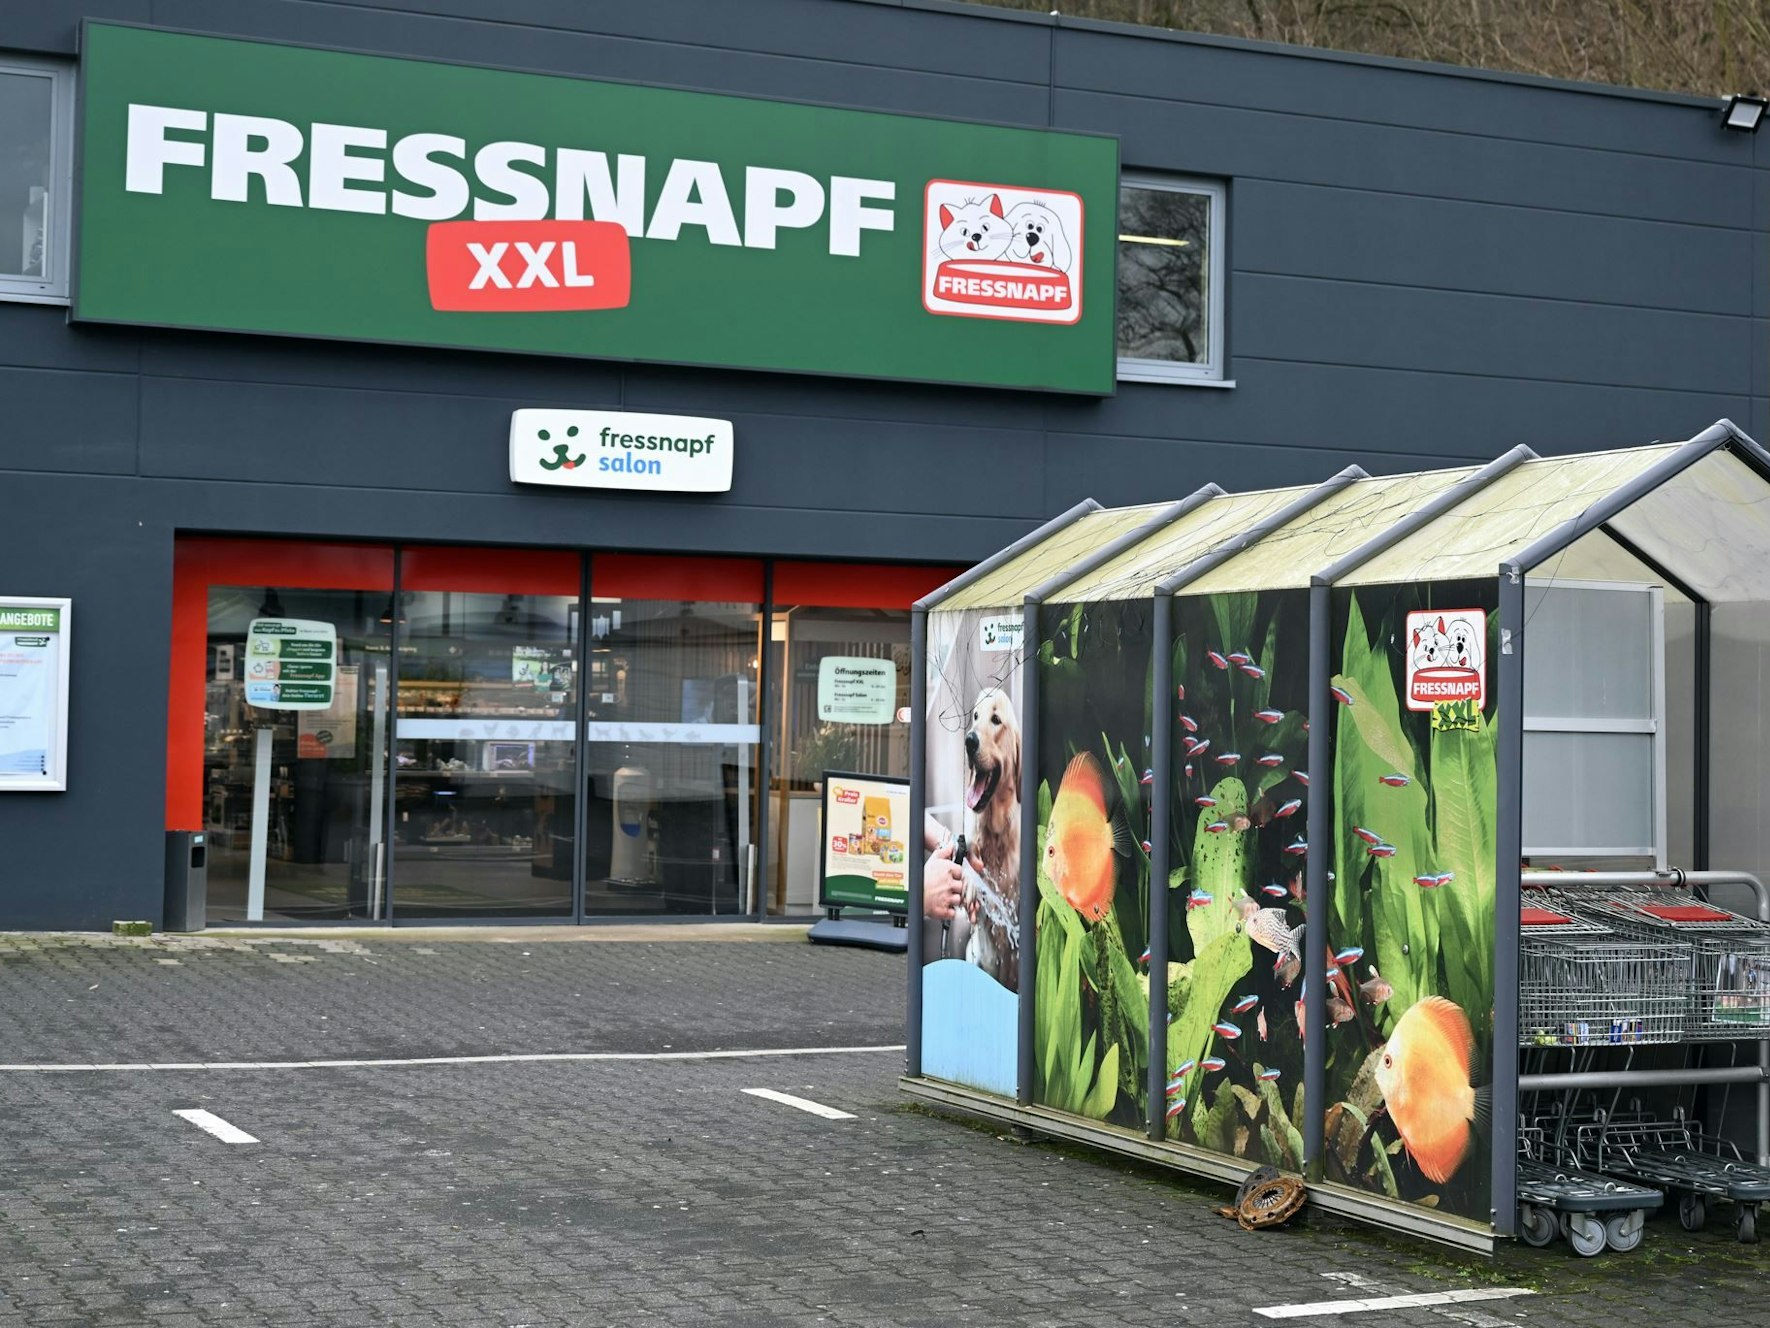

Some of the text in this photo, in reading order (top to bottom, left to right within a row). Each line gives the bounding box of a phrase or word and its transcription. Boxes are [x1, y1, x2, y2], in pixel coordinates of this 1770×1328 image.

[126, 104, 895, 257] FRESSNAPF
[466, 241, 594, 290] XXL
[938, 275, 1068, 304] FRESSNAPF
[599, 427, 716, 458] fressnapf
[599, 451, 661, 475] salon
[0, 612, 54, 627] ANGEBOTE
[1413, 682, 1480, 696] FRESSNAPF
[1437, 699, 1477, 728] XXL
